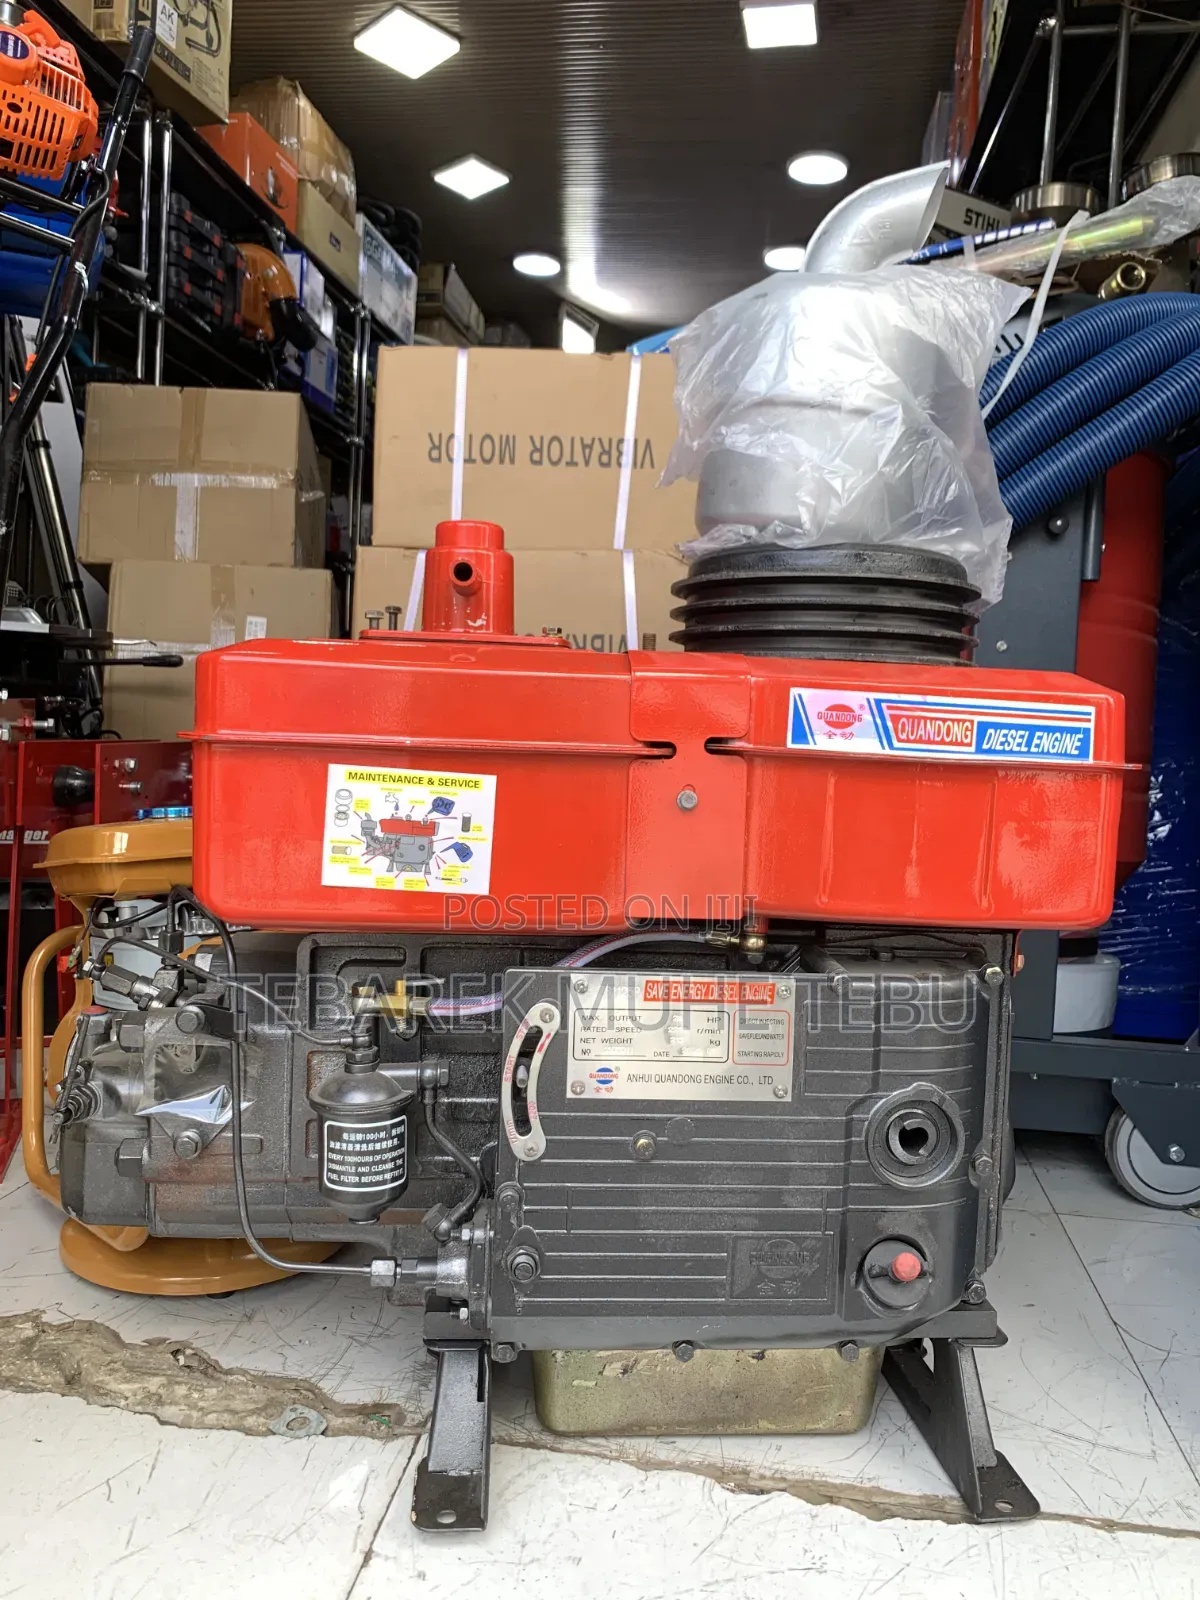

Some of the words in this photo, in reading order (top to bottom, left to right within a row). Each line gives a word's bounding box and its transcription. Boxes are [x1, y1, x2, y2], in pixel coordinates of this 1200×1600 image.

[428, 432, 517, 465] MOTOR
[528, 435, 655, 470] VIBRATOR
[817, 711, 863, 723] QUANDONG
[823, 730, 855, 741] 全动
[898, 719, 972, 743] QUANDONG
[982, 729, 1029, 752] DIESEL
[1030, 731, 1083, 755] ENGINE
[348, 771, 424, 785] MAINTENANCE
[427, 777, 435, 786] &
[437, 779, 480, 789] SERVICE
[645, 982, 670, 999] SAVE
[671, 983, 706, 1000] ENERGY
[708, 984, 738, 1000] DIESEL
[739, 985, 773, 1002] ENGINE
[709, 1039, 721, 1047] kg
[504, 1055, 516, 1083] START
[588, 1072, 619, 1080] QUANDONG
[626, 1073, 652, 1083] ANHUI
[654, 1073, 702, 1084] QUANDONG
[704, 1074, 735, 1085] ENGINE
[758, 1075, 774, 1085] LTD
[328, 1152, 343, 1161] EVERY
[328, 1163, 356, 1172] DISMANTLE
[328, 1172, 339, 1181] FUEL
[361, 1174, 384, 1182] BEFORE
